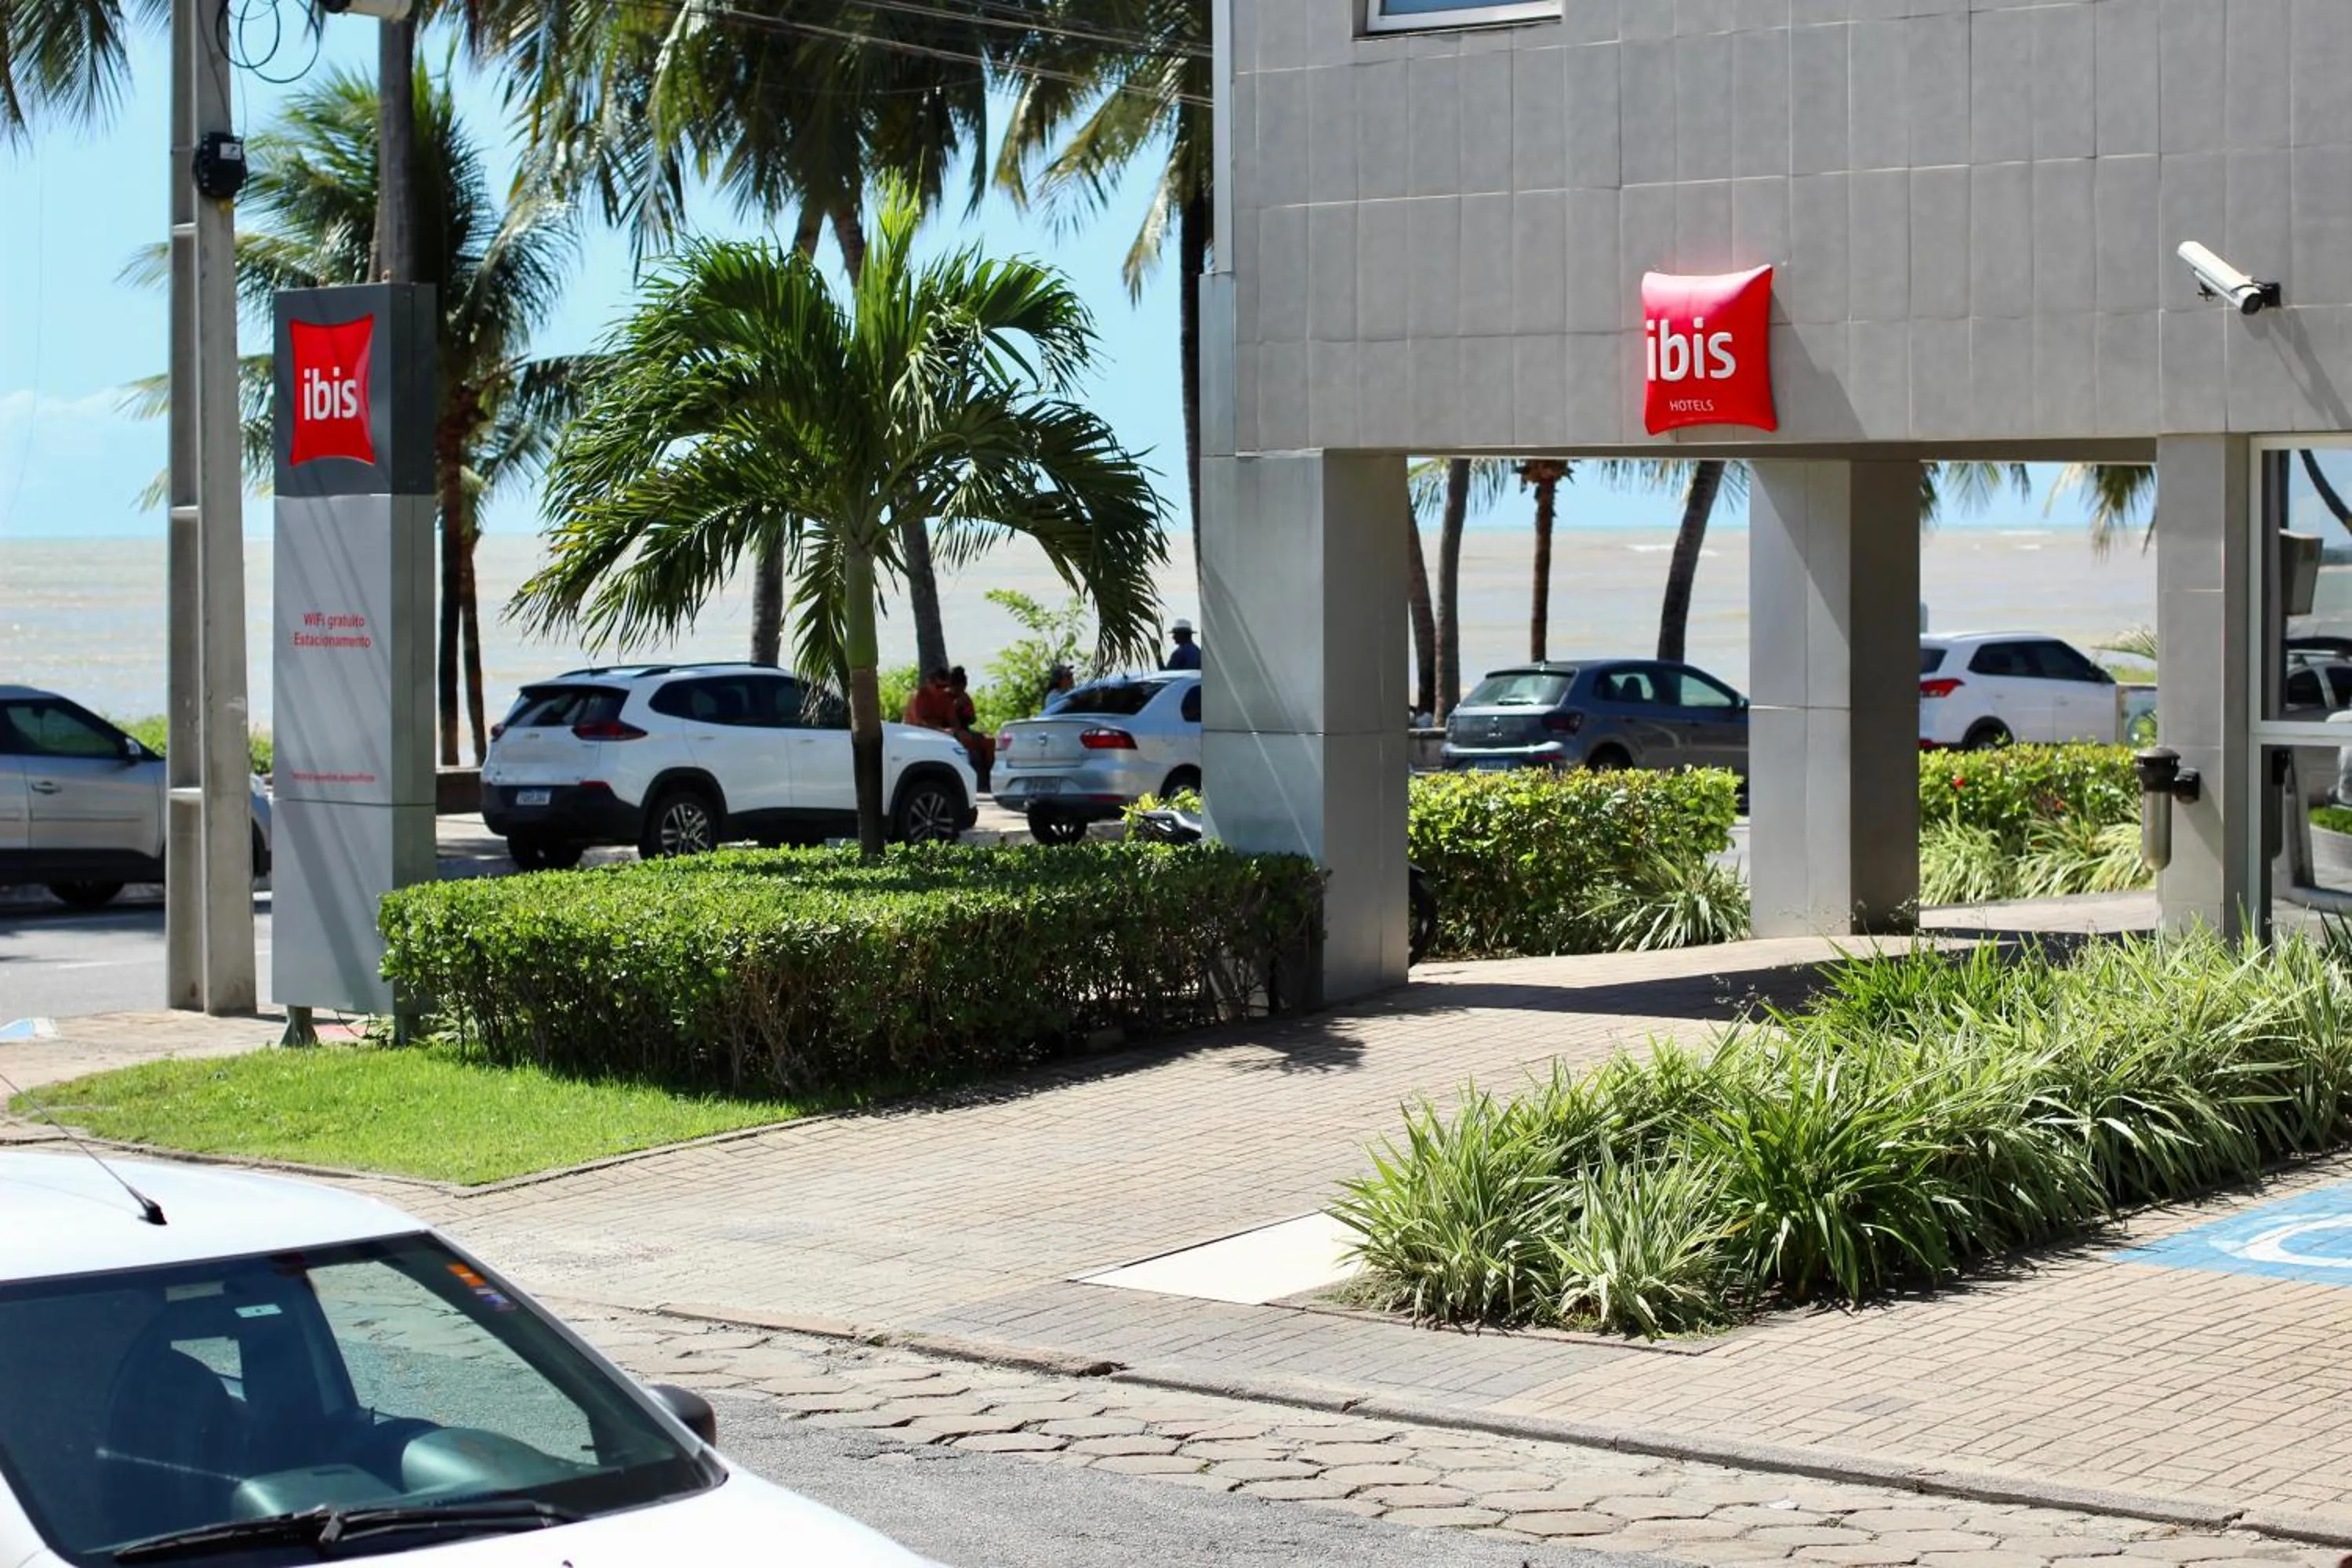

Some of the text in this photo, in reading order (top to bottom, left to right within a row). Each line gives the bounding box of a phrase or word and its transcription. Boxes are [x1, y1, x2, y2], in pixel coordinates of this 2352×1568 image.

[1646, 317, 1737, 382] ibis
[303, 366, 358, 421] ibis
[1669, 399, 1715, 412] HOTELS
[328, 615, 365, 630] gratuito
[293, 632, 371, 648] Estacionamento
